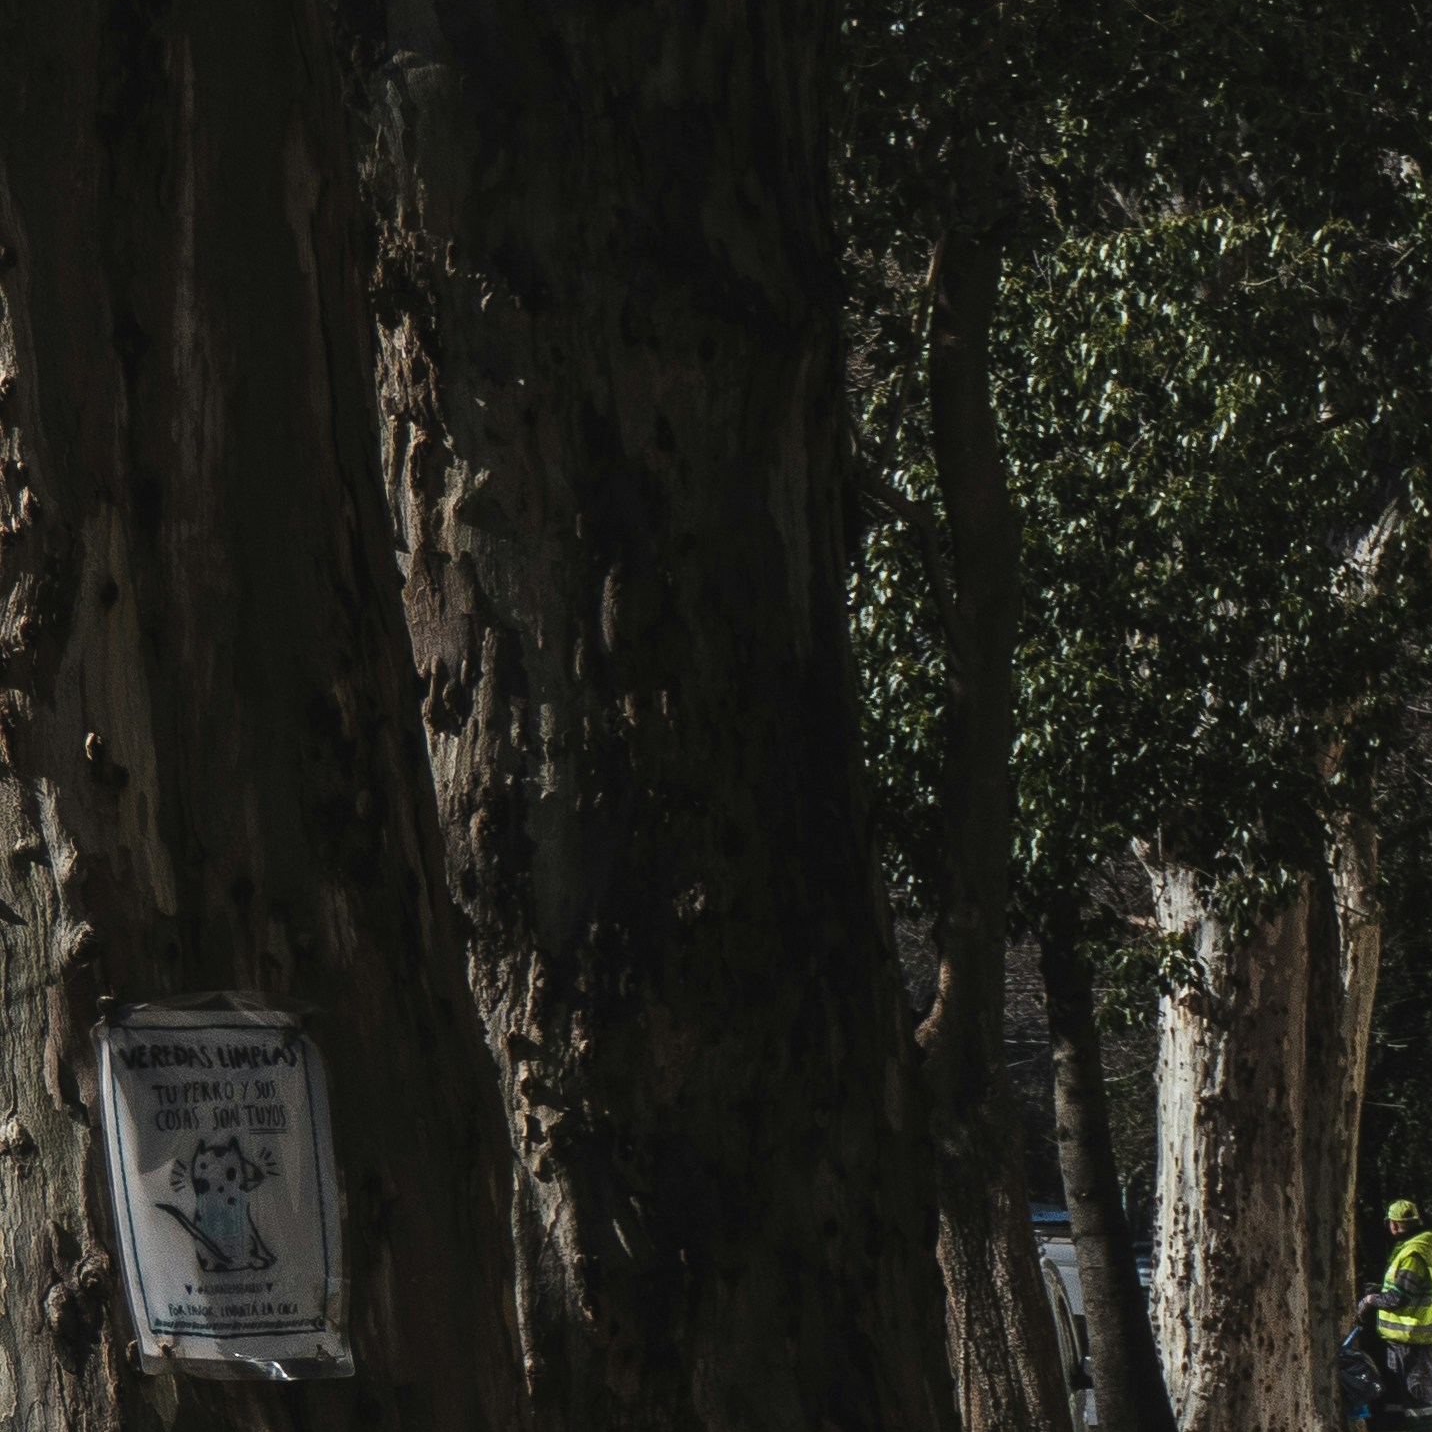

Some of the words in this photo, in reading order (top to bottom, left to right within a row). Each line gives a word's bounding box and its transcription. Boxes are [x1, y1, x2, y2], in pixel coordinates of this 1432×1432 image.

[119, 1044, 213, 1070] VEREDAS
[152, 1084, 178, 1105] TU
[183, 1081, 235, 1103] PERRO
[240, 1081, 249, 1101] Y
[254, 1080, 276, 1099] SUS
[155, 1106, 200, 1131] COSAS
[212, 1104, 240, 1130] SON
[244, 1104, 286, 1128] TUYOS
[168, 1303, 187, 1317] POR
